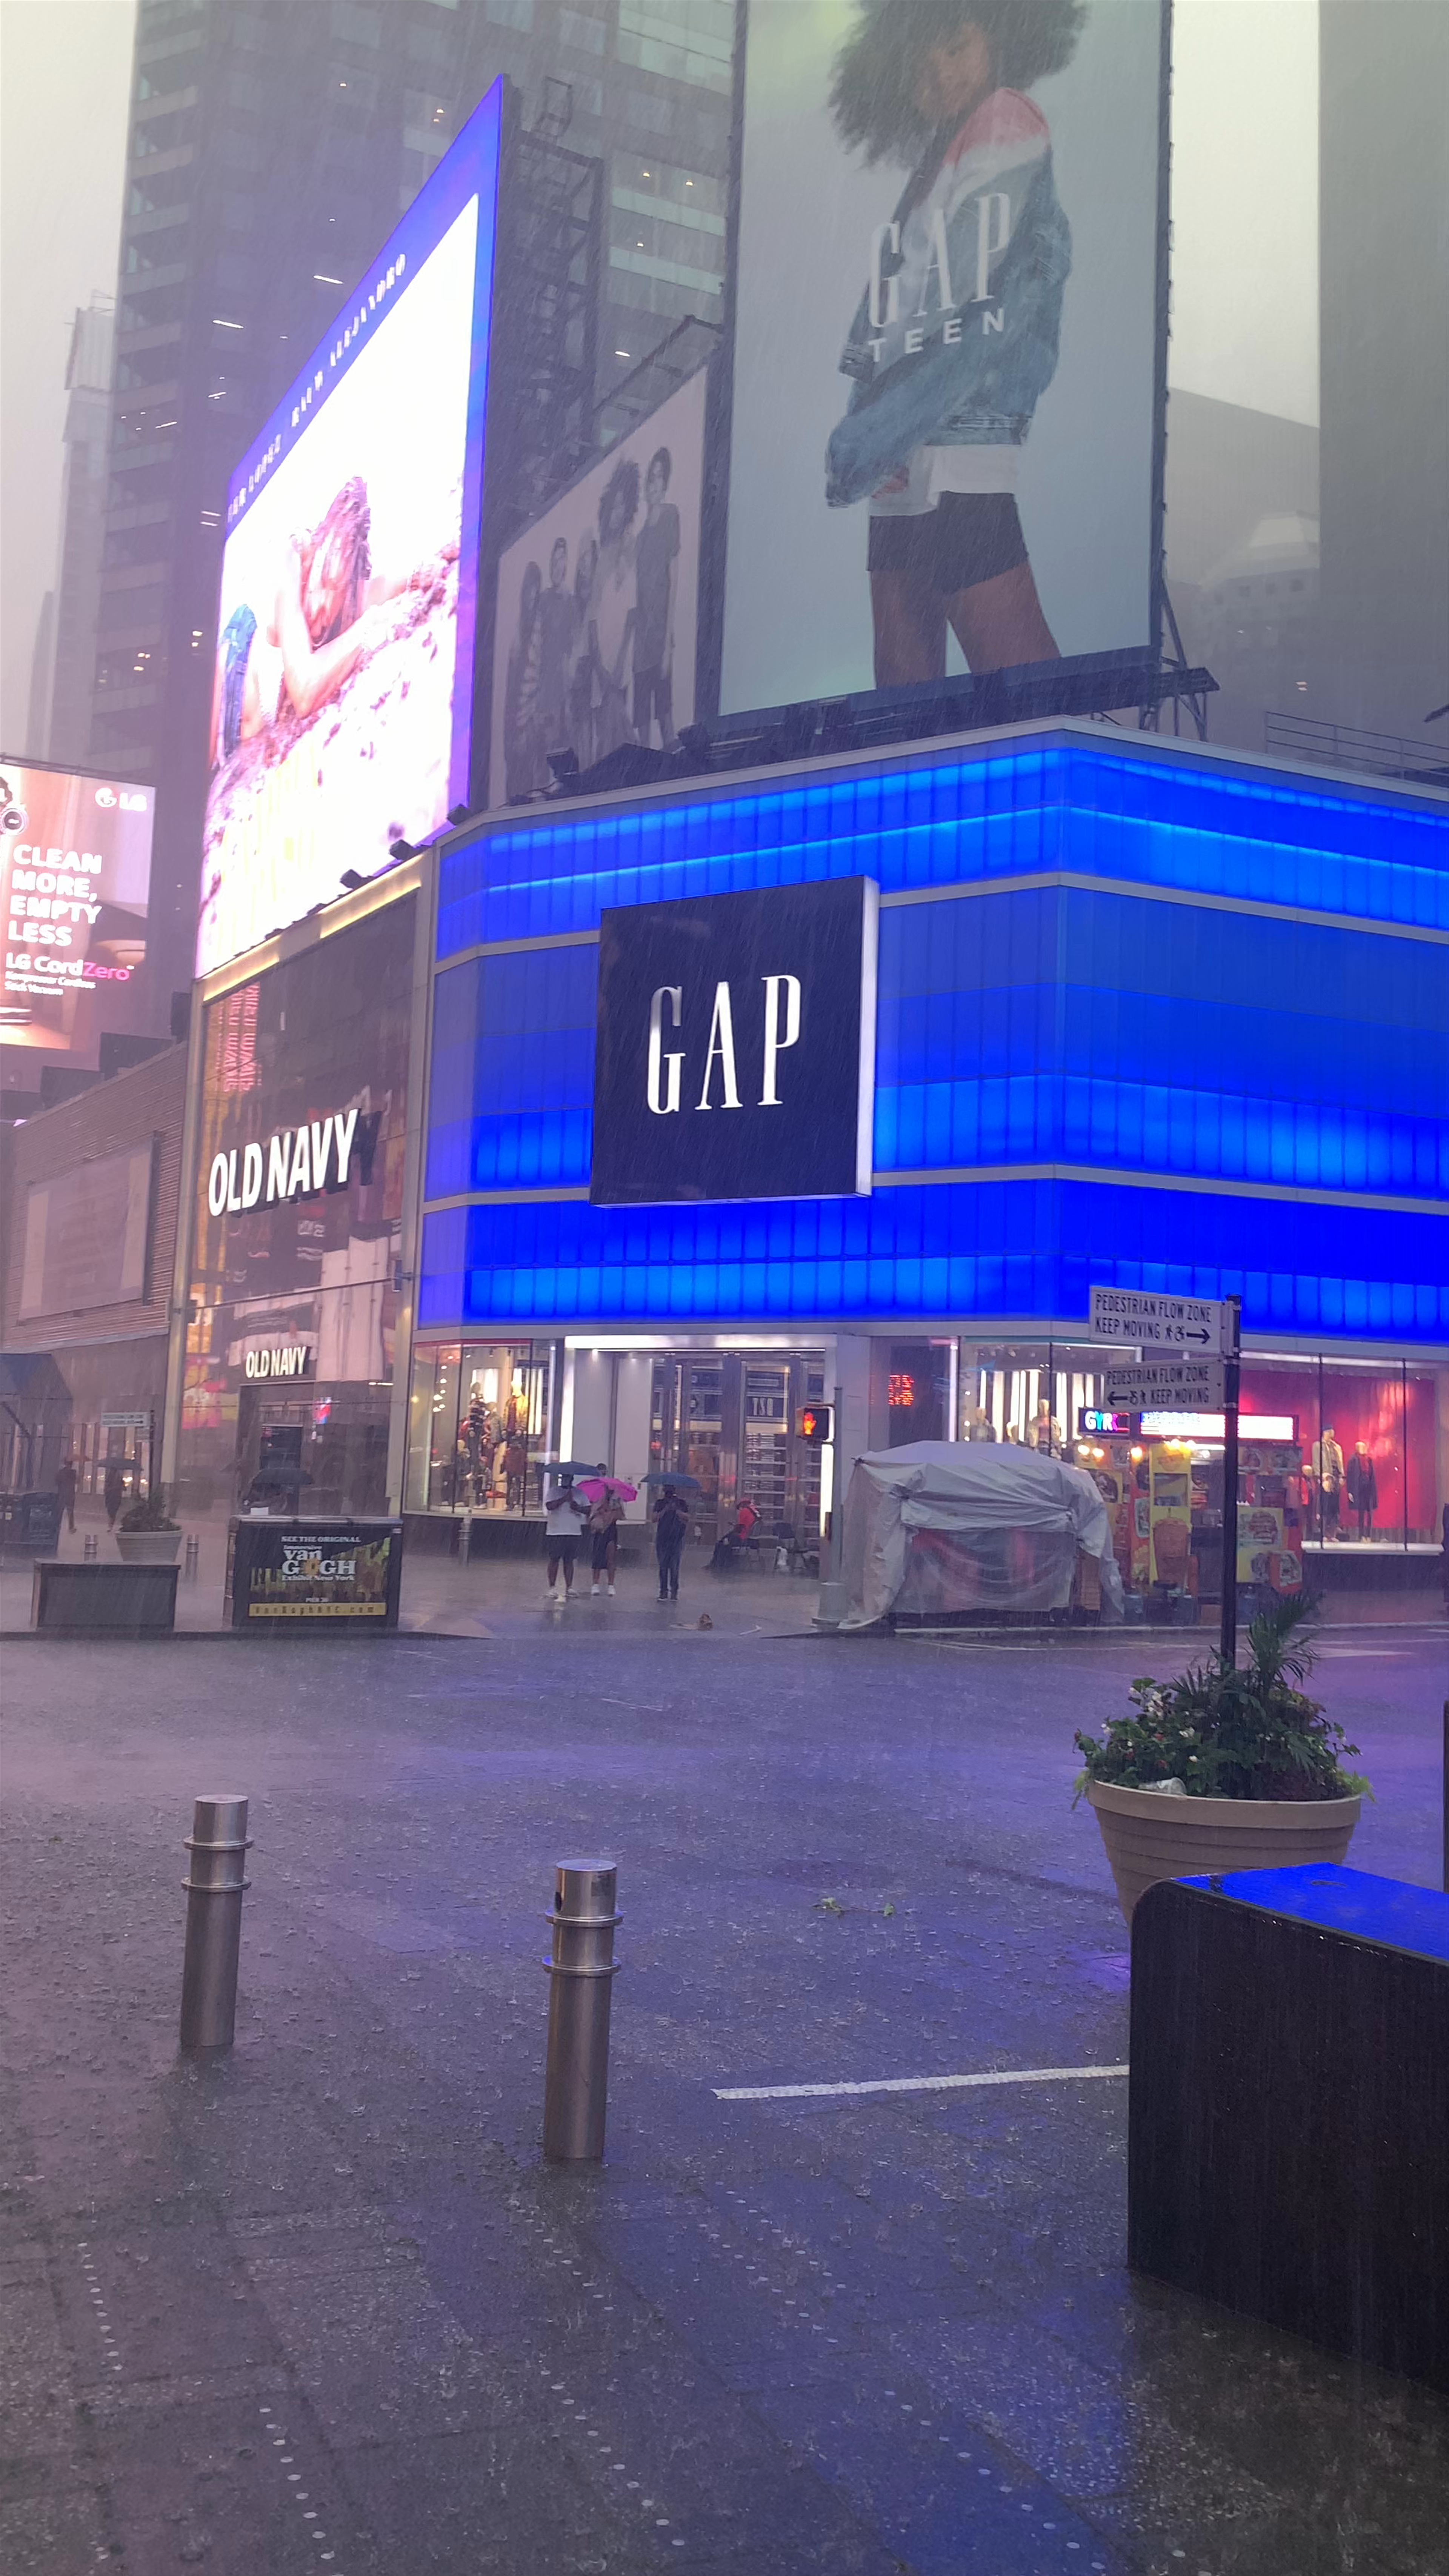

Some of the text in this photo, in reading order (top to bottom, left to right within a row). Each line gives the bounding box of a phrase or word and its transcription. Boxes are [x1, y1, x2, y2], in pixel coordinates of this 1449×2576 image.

[869, 192, 1011, 328] GAP
[869, 308, 1004, 362] TEEN
[119, 792, 148, 811] LG
[13, 844, 102, 874] CLEAN
[12, 869, 97, 902] MORE,
[10, 895, 102, 924] EMPTY
[8, 920, 72, 946] LESS
[5, 952, 31, 970] LG
[647, 975, 801, 1115] GAP
[209, 1109, 358, 1216] OLD NAVY
[1096, 1293, 1212, 1323] PEDESTRIAN FLOW ZONE
[1095, 1317, 1160, 1339] KEEP MOVING
[246, 1346, 307, 1378] OLD NAVY
[1106, 1366, 1209, 1385] PEDESTRIAN FLOW ZONE
[1150, 1389, 1172, 1404] KEEP
[282, 1560, 356, 1575] GGH
[283, 1550, 322, 1560] van
